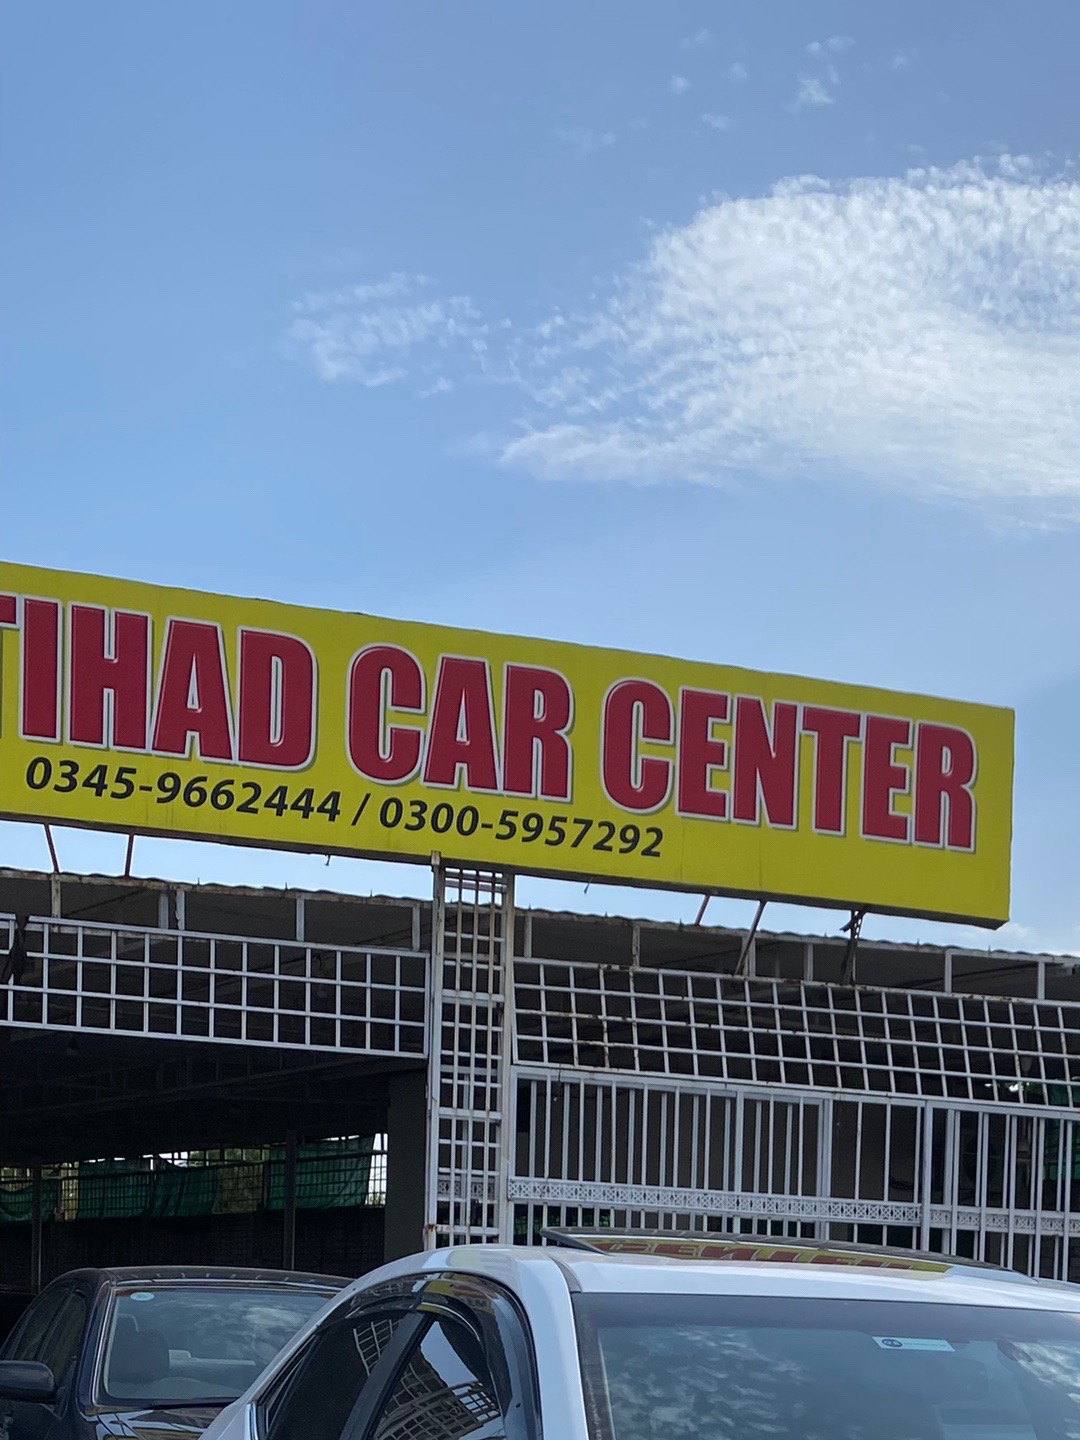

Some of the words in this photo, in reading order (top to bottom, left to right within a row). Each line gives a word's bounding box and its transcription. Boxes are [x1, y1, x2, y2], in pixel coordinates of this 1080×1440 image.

[26, 756, 341, 822] 0345-9662444
[379, 797, 663, 858] 0300-5957292
[346, 643, 573, 803] CAR
[602, 677, 977, 853] CENTER
